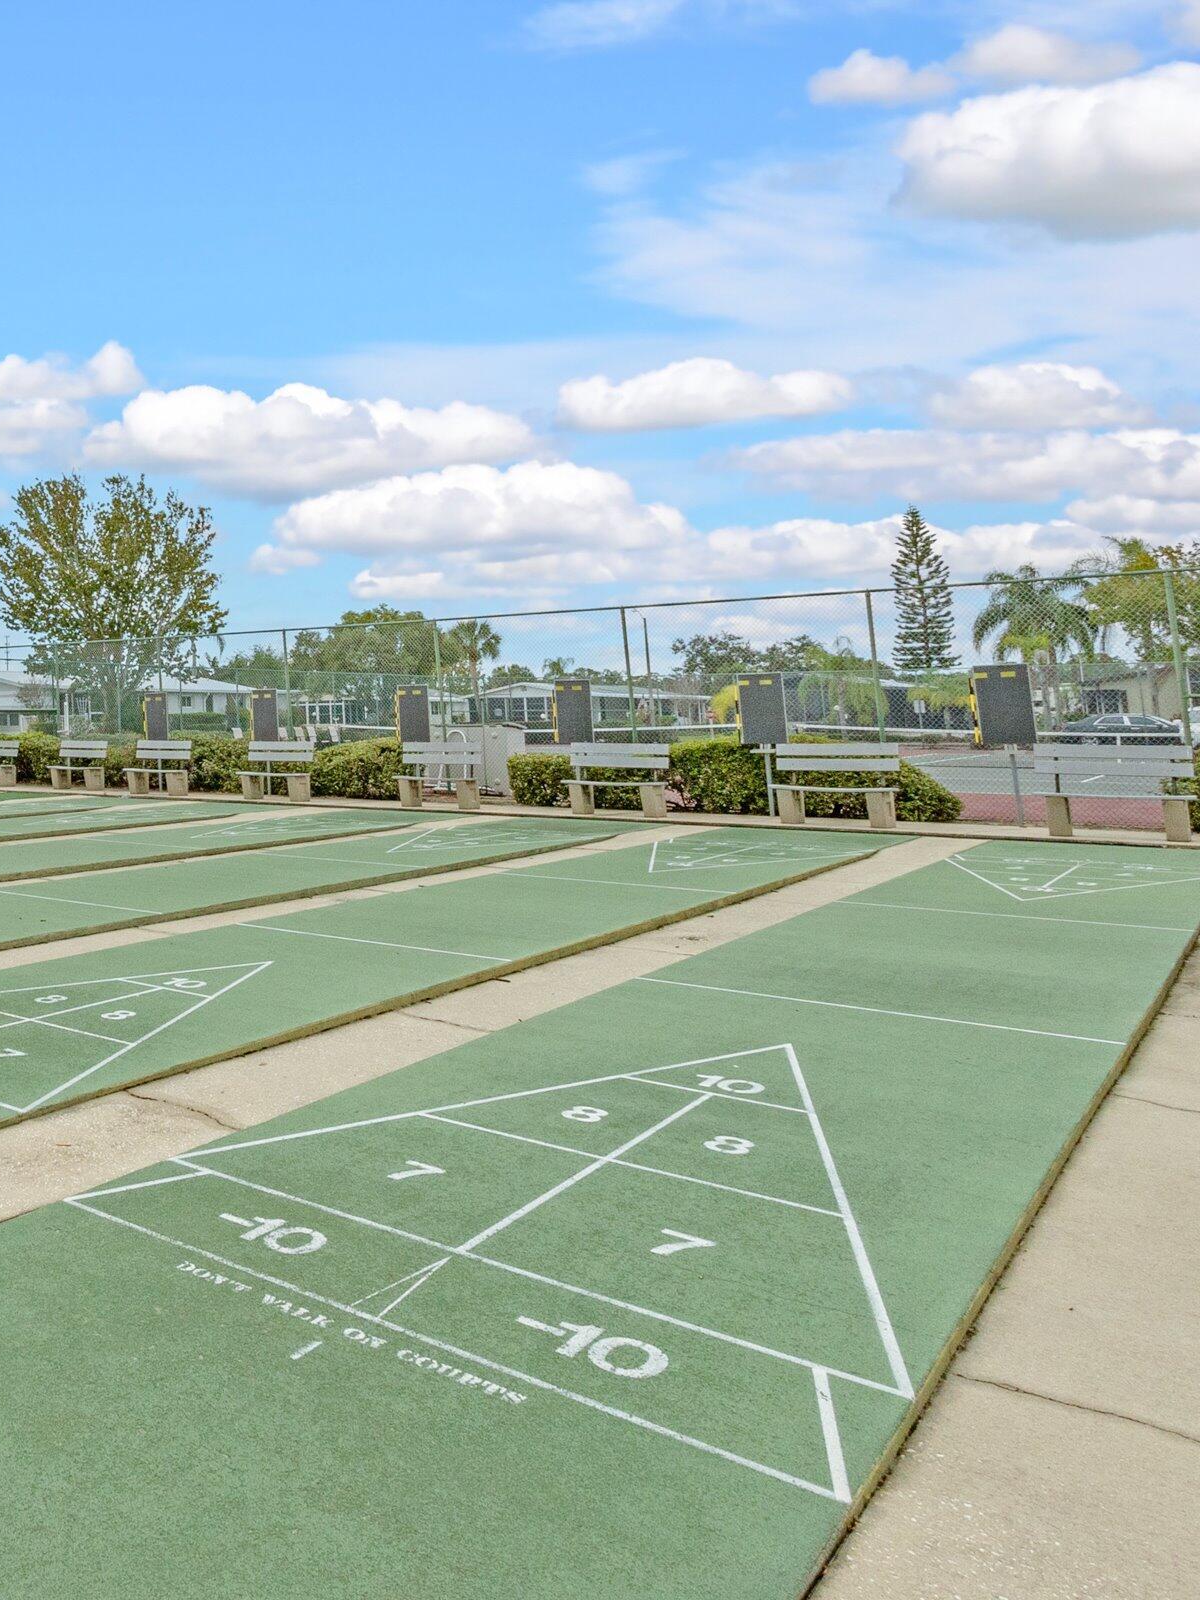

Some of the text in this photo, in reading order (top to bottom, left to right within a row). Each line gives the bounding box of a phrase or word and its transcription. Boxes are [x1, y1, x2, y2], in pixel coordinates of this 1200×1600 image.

[163, 977, 207, 989] 10
[35, 995, 68, 1004] 8
[101, 1009, 136, 1020] 8
[696, 1074, 766, 1097] 10
[561, 1106, 609, 1124] 8
[703, 1136, 756, 1156] 8
[387, 1160, 447, 1181] 7
[219, 1213, 328, 1255] -10
[649, 1228, 717, 1256] 7
[176, 1260, 528, 1405] DON'T WALK ON COURTS
[515, 1315, 670, 1379] -10
